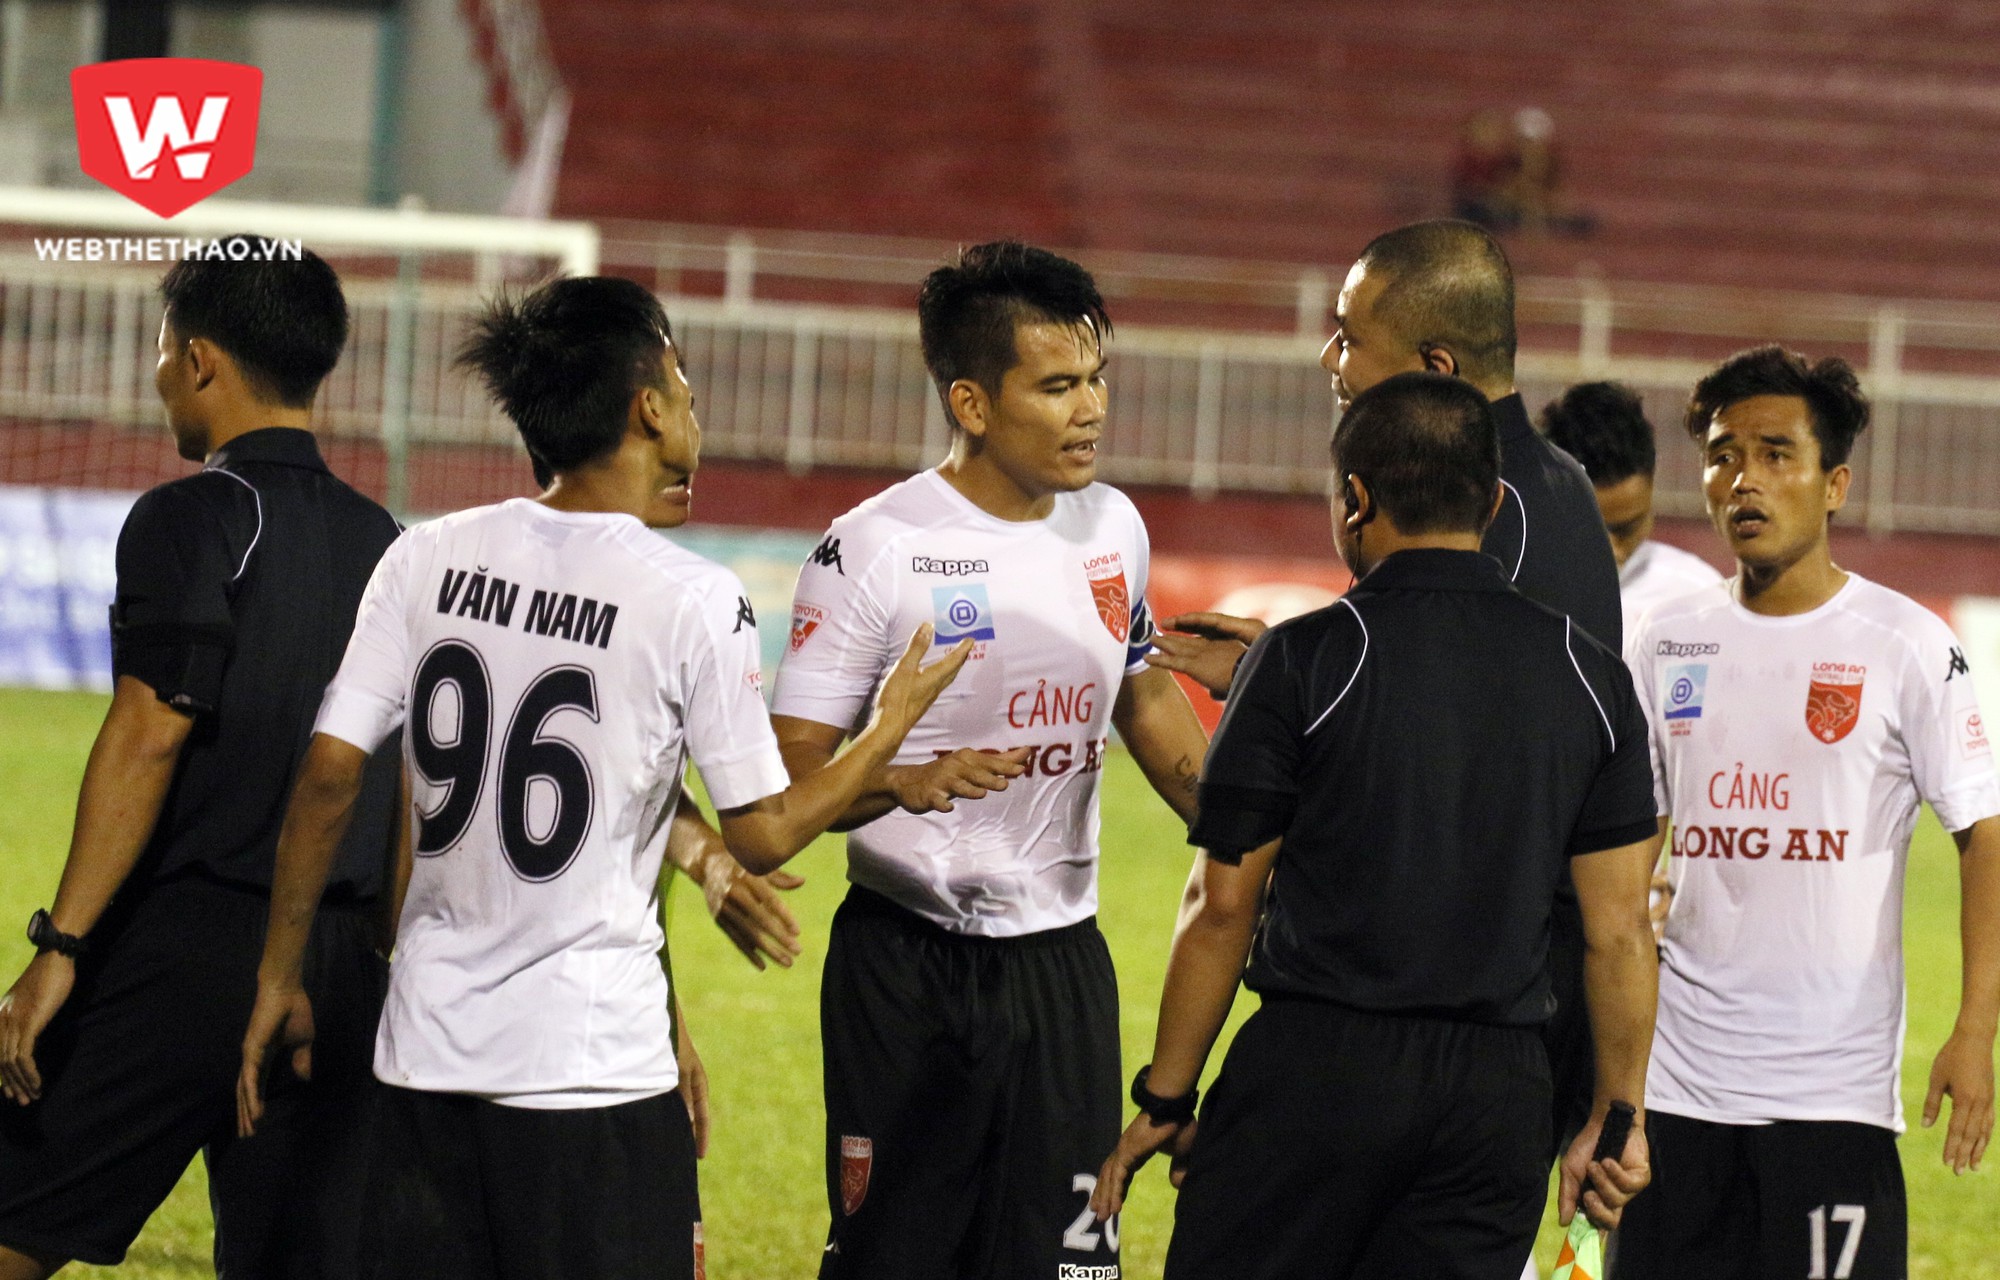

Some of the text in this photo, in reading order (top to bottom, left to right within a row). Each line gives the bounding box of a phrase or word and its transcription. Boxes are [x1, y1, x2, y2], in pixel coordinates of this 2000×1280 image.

[913, 557, 989, 576] Kappa
[437, 564, 618, 649] VĂN NAM
[1656, 640, 1720, 657] Kappa
[1008, 679, 1095, 728] CẢNG
[411, 638, 600, 884] 96
[1709, 762, 1789, 811] CẢNG
[1671, 825, 1849, 861] LONG AN
[1807, 1204, 1867, 1279] 17
[1058, 1264, 1119, 1280] Kappa
